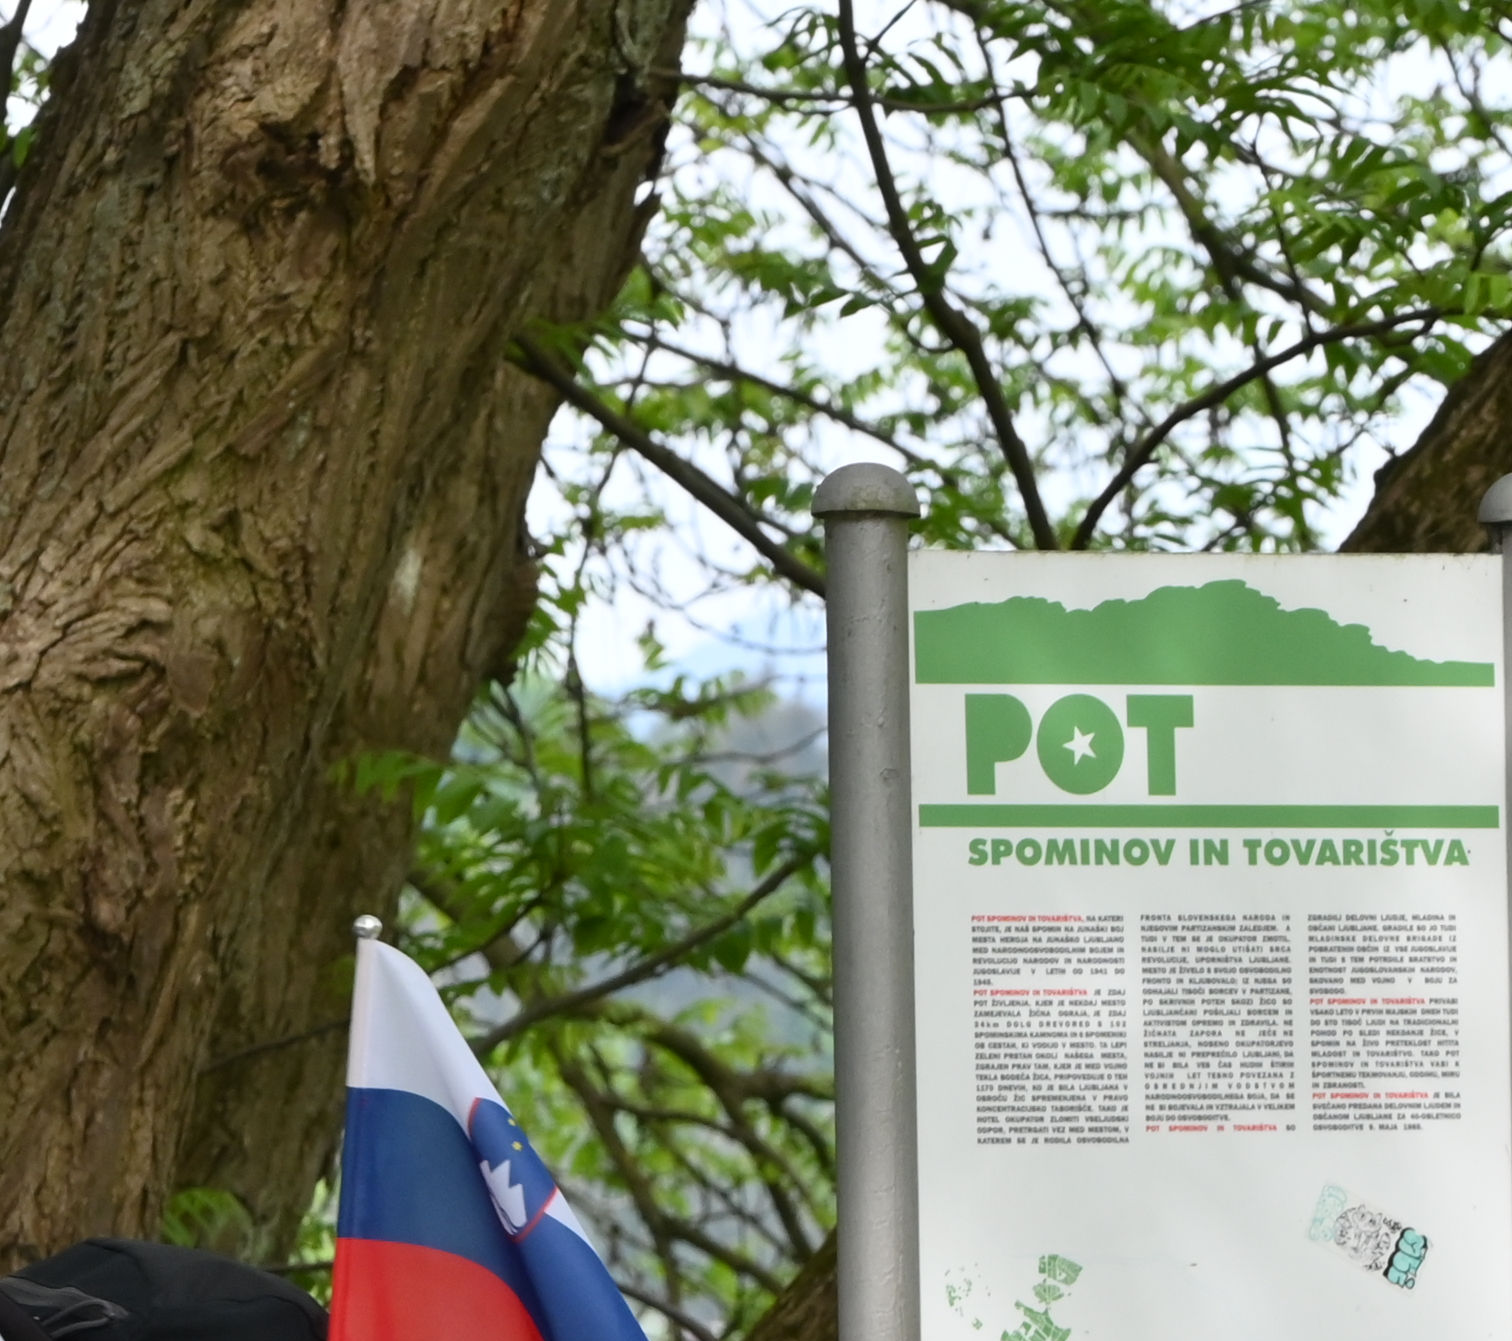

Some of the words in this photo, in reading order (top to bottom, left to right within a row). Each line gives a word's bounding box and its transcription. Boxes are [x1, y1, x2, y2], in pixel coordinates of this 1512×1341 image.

[965, 693, 1195, 796] POT
[968, 838, 1176, 867] SPOMINOV
[1190, 838, 1230, 867] IN
[1243, 830, 1470, 867] TOVARIŠTVA
